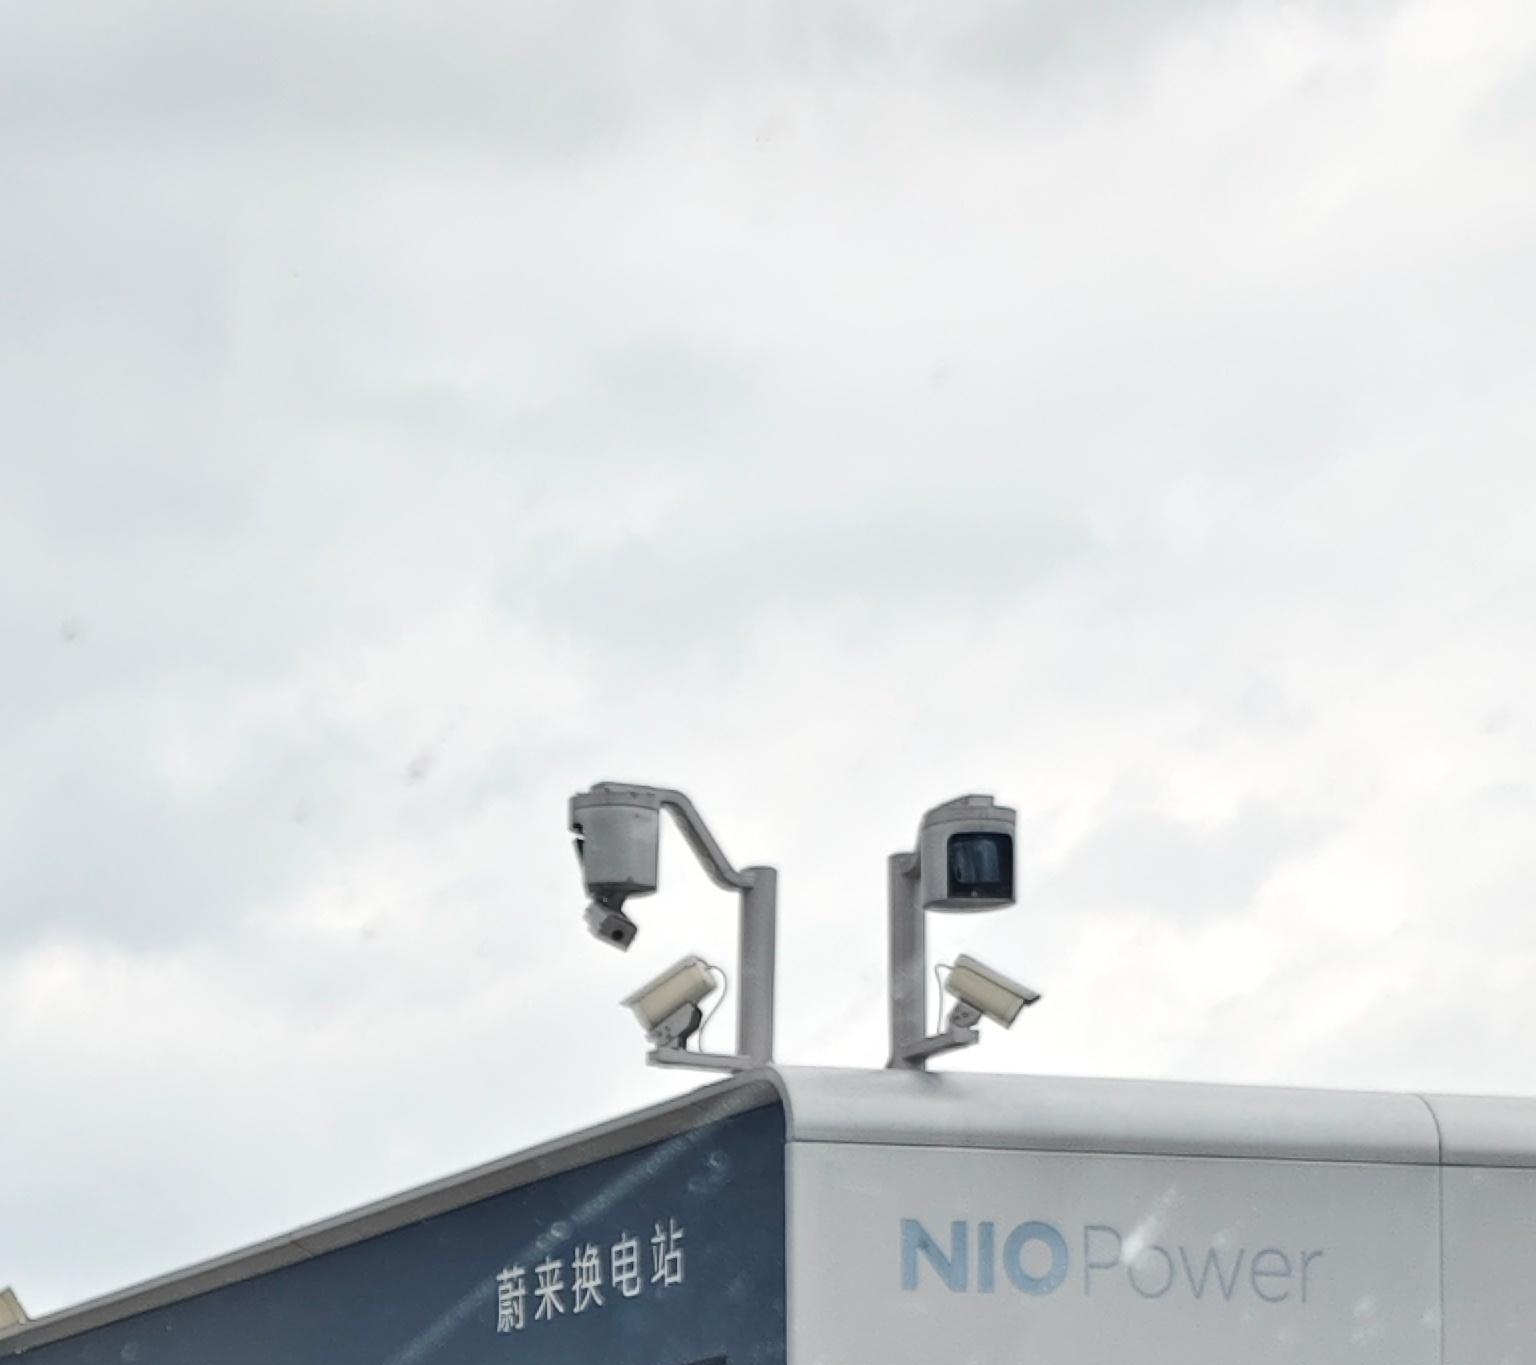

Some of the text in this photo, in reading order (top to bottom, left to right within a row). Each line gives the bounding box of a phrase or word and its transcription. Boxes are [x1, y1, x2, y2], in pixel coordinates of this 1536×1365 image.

[496, 1217, 685, 1333] 蔚来换电站
